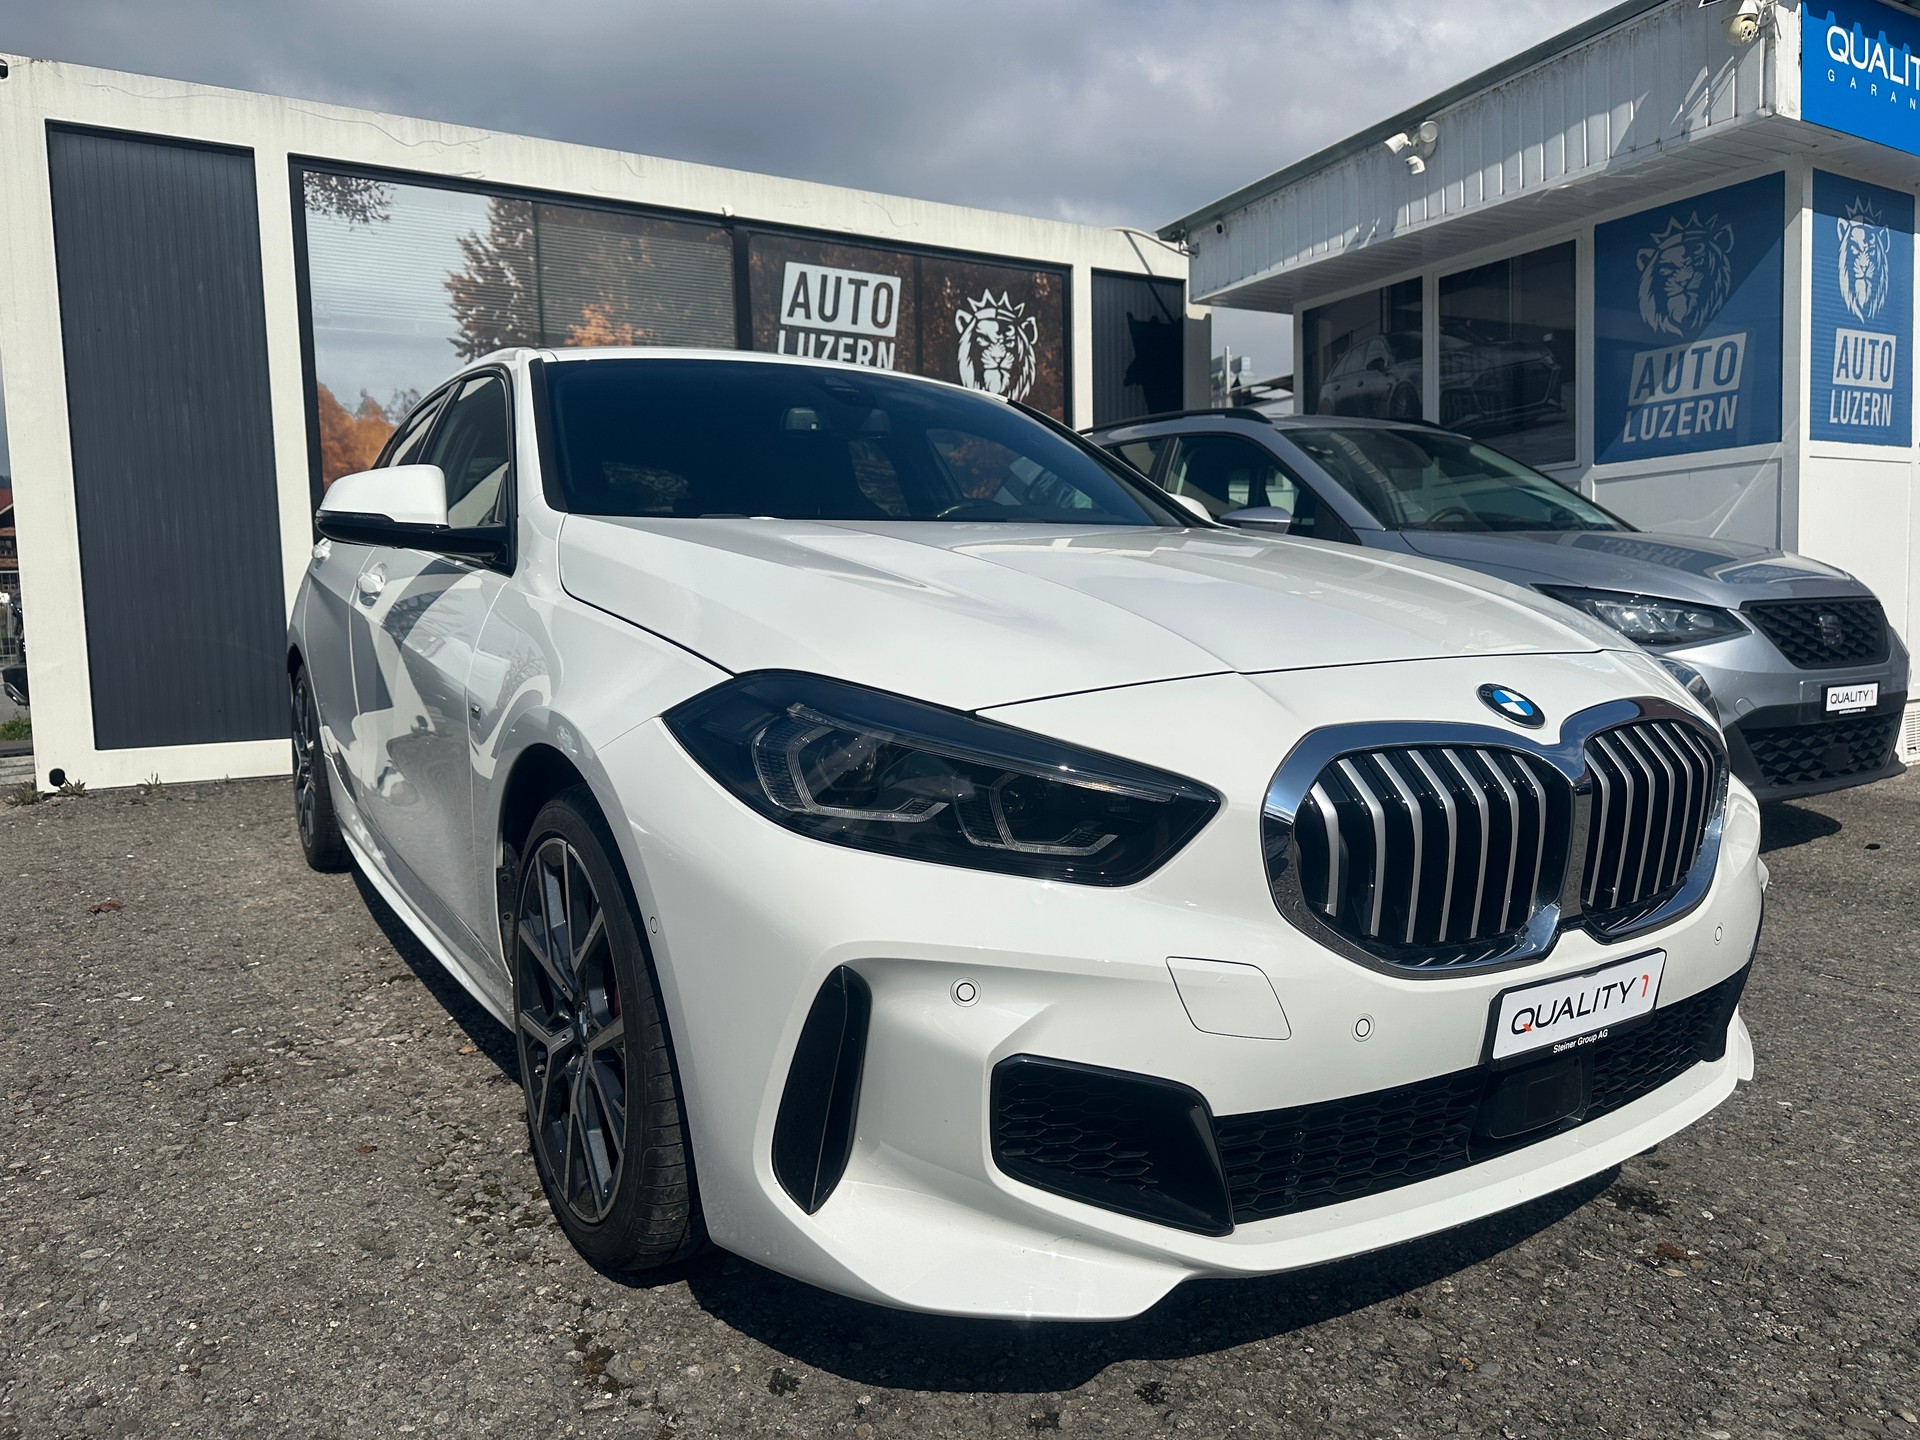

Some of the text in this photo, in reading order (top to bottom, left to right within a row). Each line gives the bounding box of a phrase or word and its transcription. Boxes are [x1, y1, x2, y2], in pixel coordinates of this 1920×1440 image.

[1826, 26, 1920, 91] QUALIT
[787, 271, 893, 329] AUTO
[778, 330, 895, 370] LUZERN
[1633, 340, 1737, 400] AUTO
[1836, 335, 1892, 382] AUTO
[1622, 395, 1738, 444] LUZERN
[1829, 389, 1892, 427] LUZERN
[1830, 689, 1873, 704] QUALITY 1
[1511, 974, 1649, 1035] QUALITY 1
[1553, 1029, 1608, 1053] Steiner Group AG
